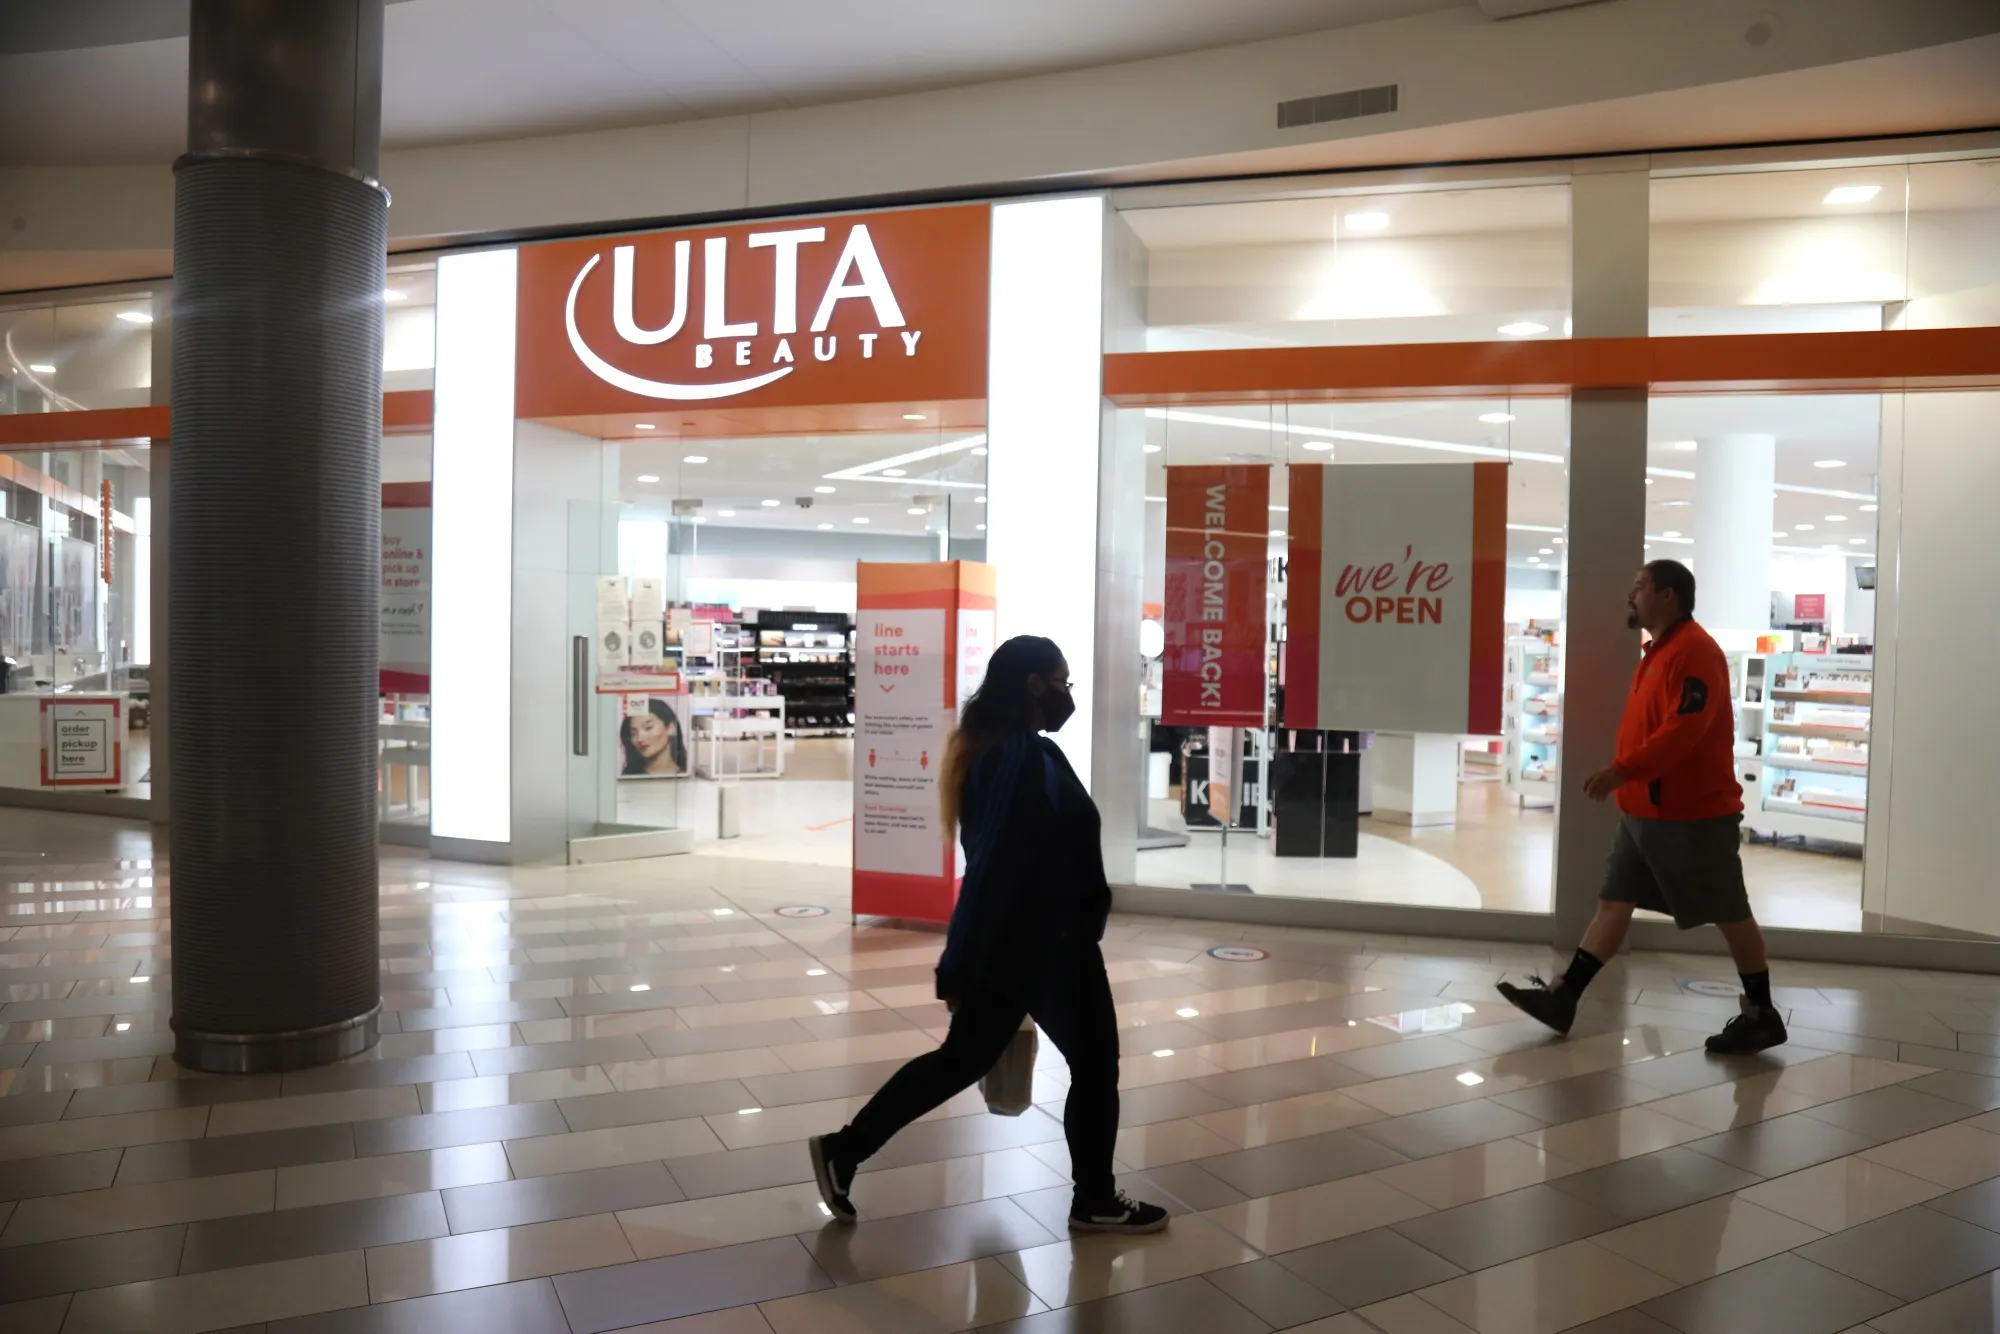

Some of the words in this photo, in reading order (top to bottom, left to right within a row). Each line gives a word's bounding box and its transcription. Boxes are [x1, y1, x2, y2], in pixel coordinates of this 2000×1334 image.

[612, 223, 906, 345] ULTA
[695, 330, 922, 369] BEAUTY
[1204, 483, 1226, 621] WELCOME
[1335, 544, 1454, 598] we're
[1345, 596, 1443, 624] OPEN
[874, 623, 904, 637] line
[874, 644, 920, 657] starts
[874, 661, 909, 675] here
[1201, 628, 1223, 708] BACK!
[61, 724, 90, 733] order
[61, 740, 98, 749] pickup
[61, 755, 85, 763] here
